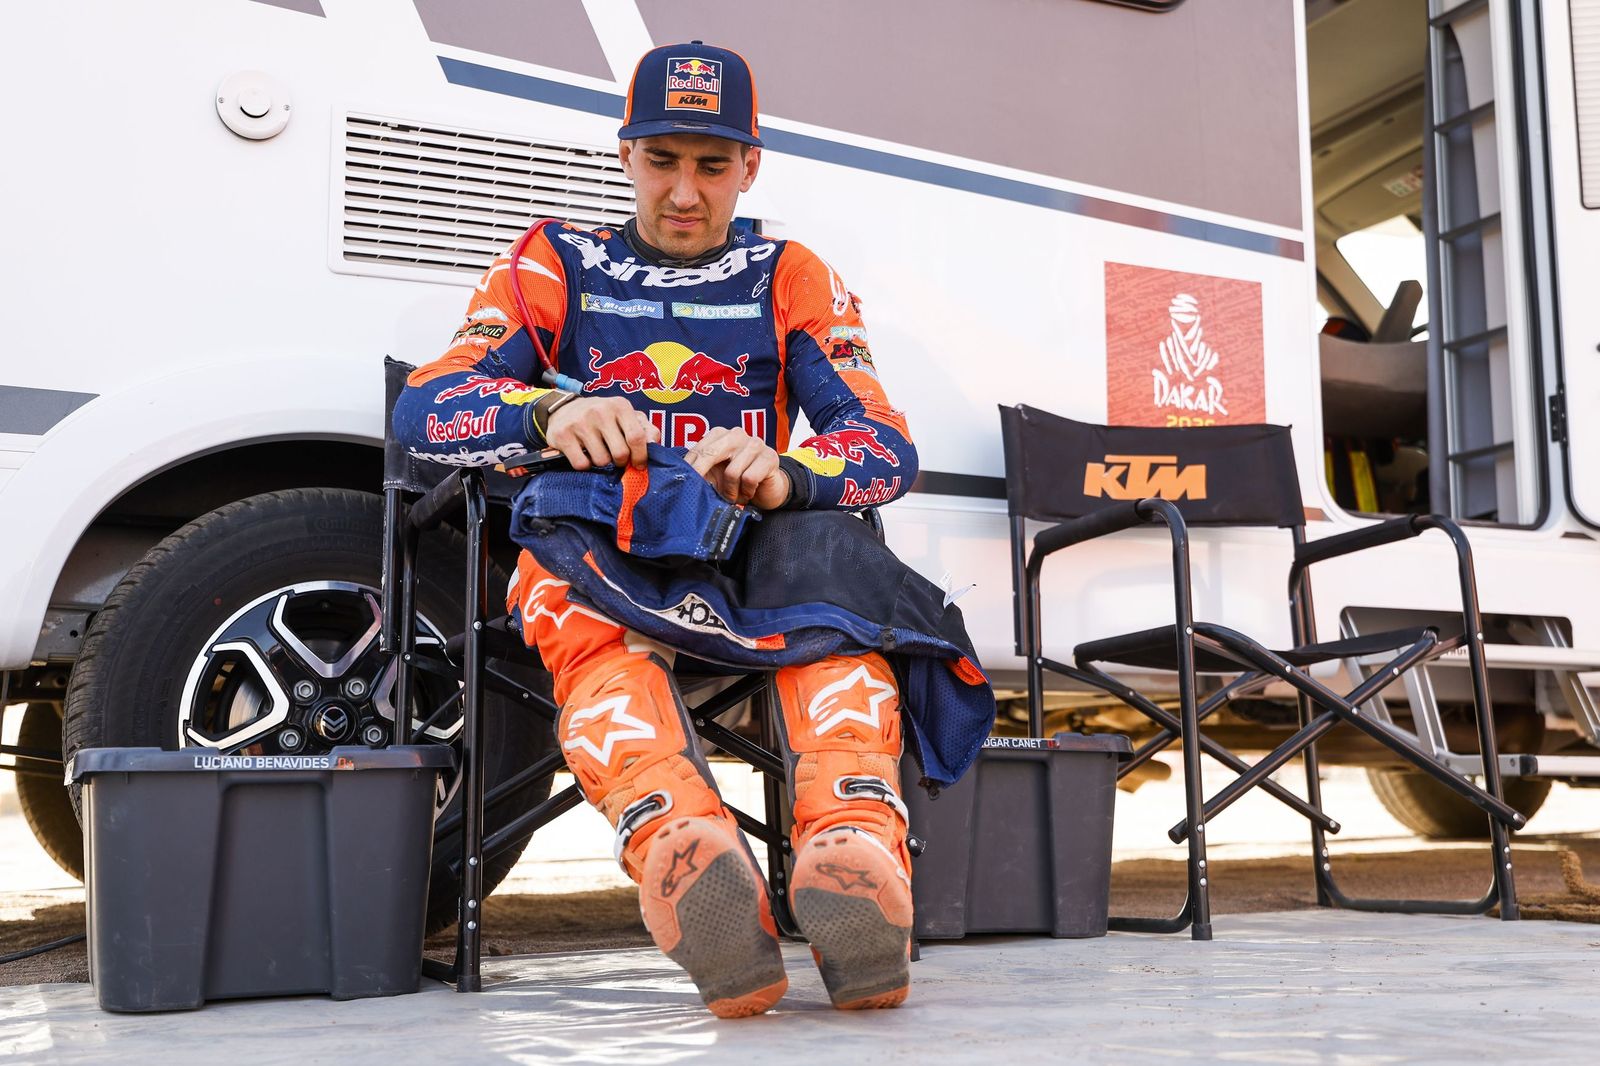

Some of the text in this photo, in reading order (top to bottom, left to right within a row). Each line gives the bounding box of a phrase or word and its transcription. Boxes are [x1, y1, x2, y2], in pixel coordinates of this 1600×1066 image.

[669, 75, 719, 93] Red Bull
[678, 95, 708, 106] KTM
[602, 301, 657, 313] MICHELIN
[694, 304, 758, 318] MOTOREX
[1152, 368, 1229, 416] DAKAR
[427, 406, 501, 443] Red Bull
[1083, 454, 1207, 501] KTM
[837, 476, 901, 506] Red Bull
[982, 738, 1042, 748] DGAR CANET
[194, 756, 329, 769] LUCIANO BENAVIDES
